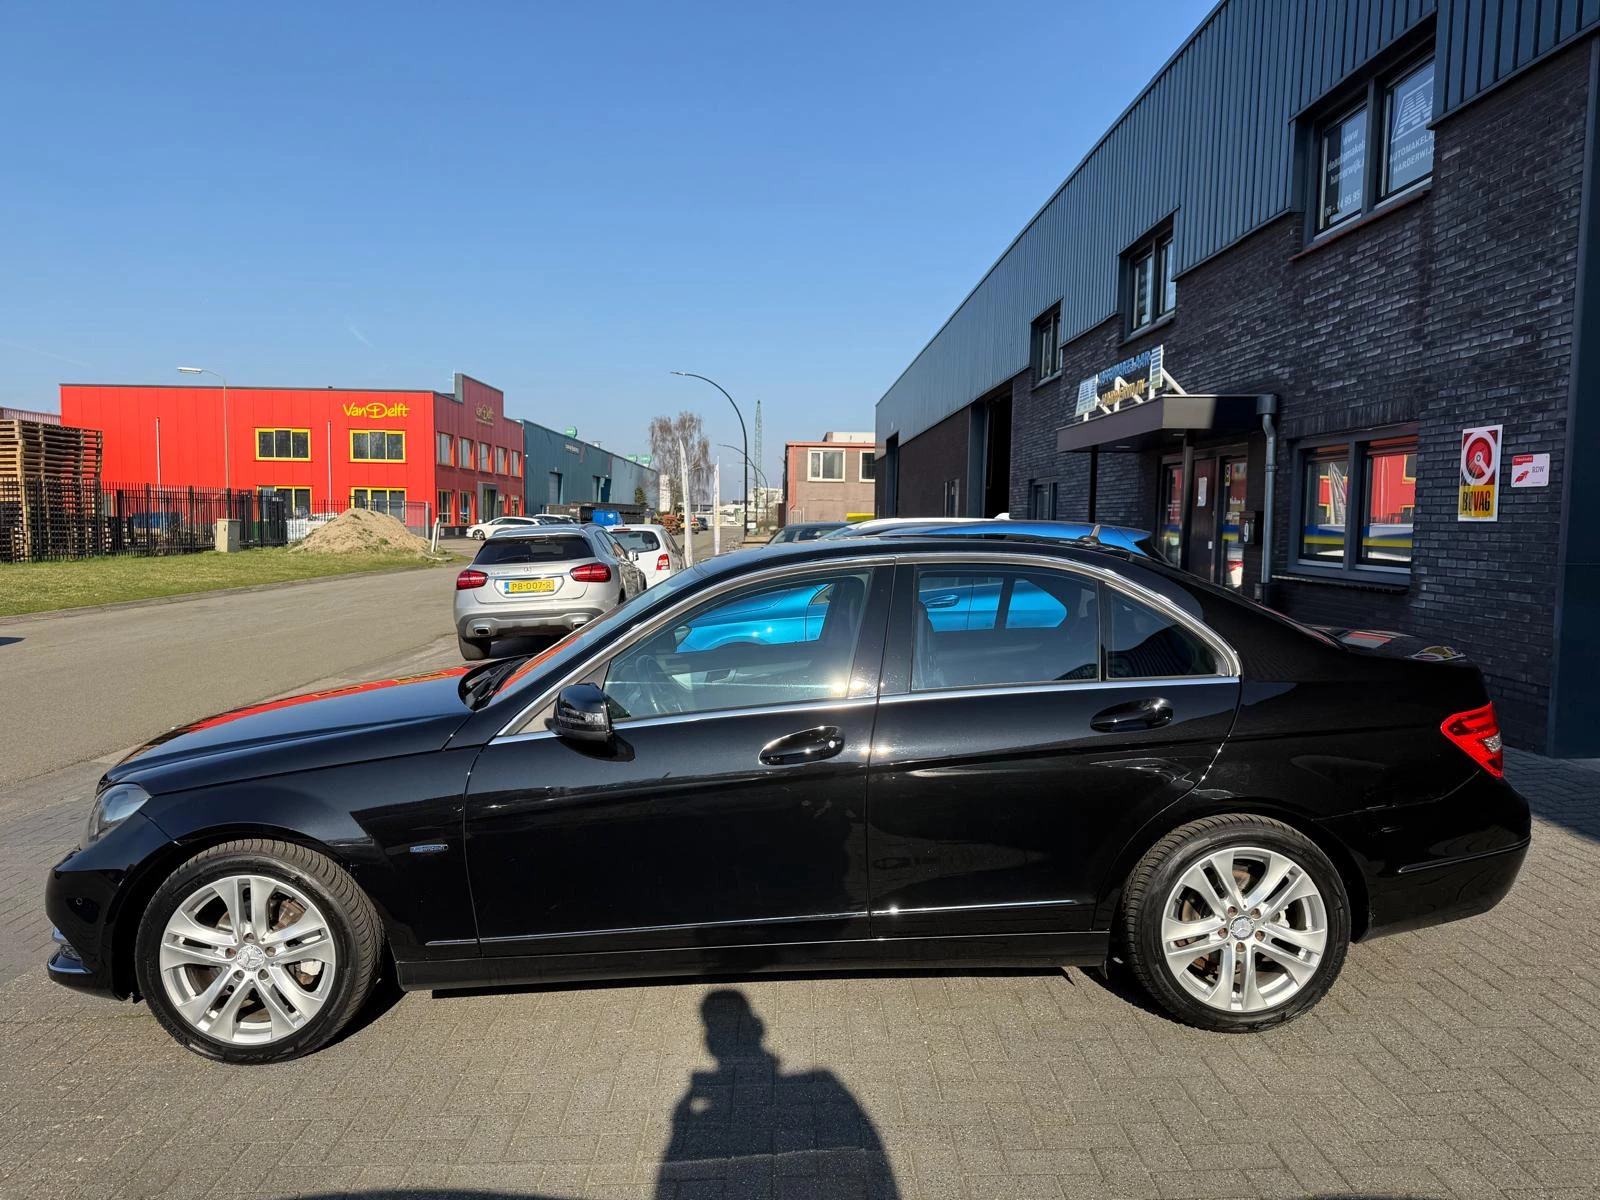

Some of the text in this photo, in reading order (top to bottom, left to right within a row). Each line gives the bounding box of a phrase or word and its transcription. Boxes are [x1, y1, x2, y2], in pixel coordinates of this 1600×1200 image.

[1389, 132, 1435, 163] AUTOMAKELA
[1393, 147, 1435, 174] HARDERWIJ
[1462, 490, 1491, 512] BOVAG
